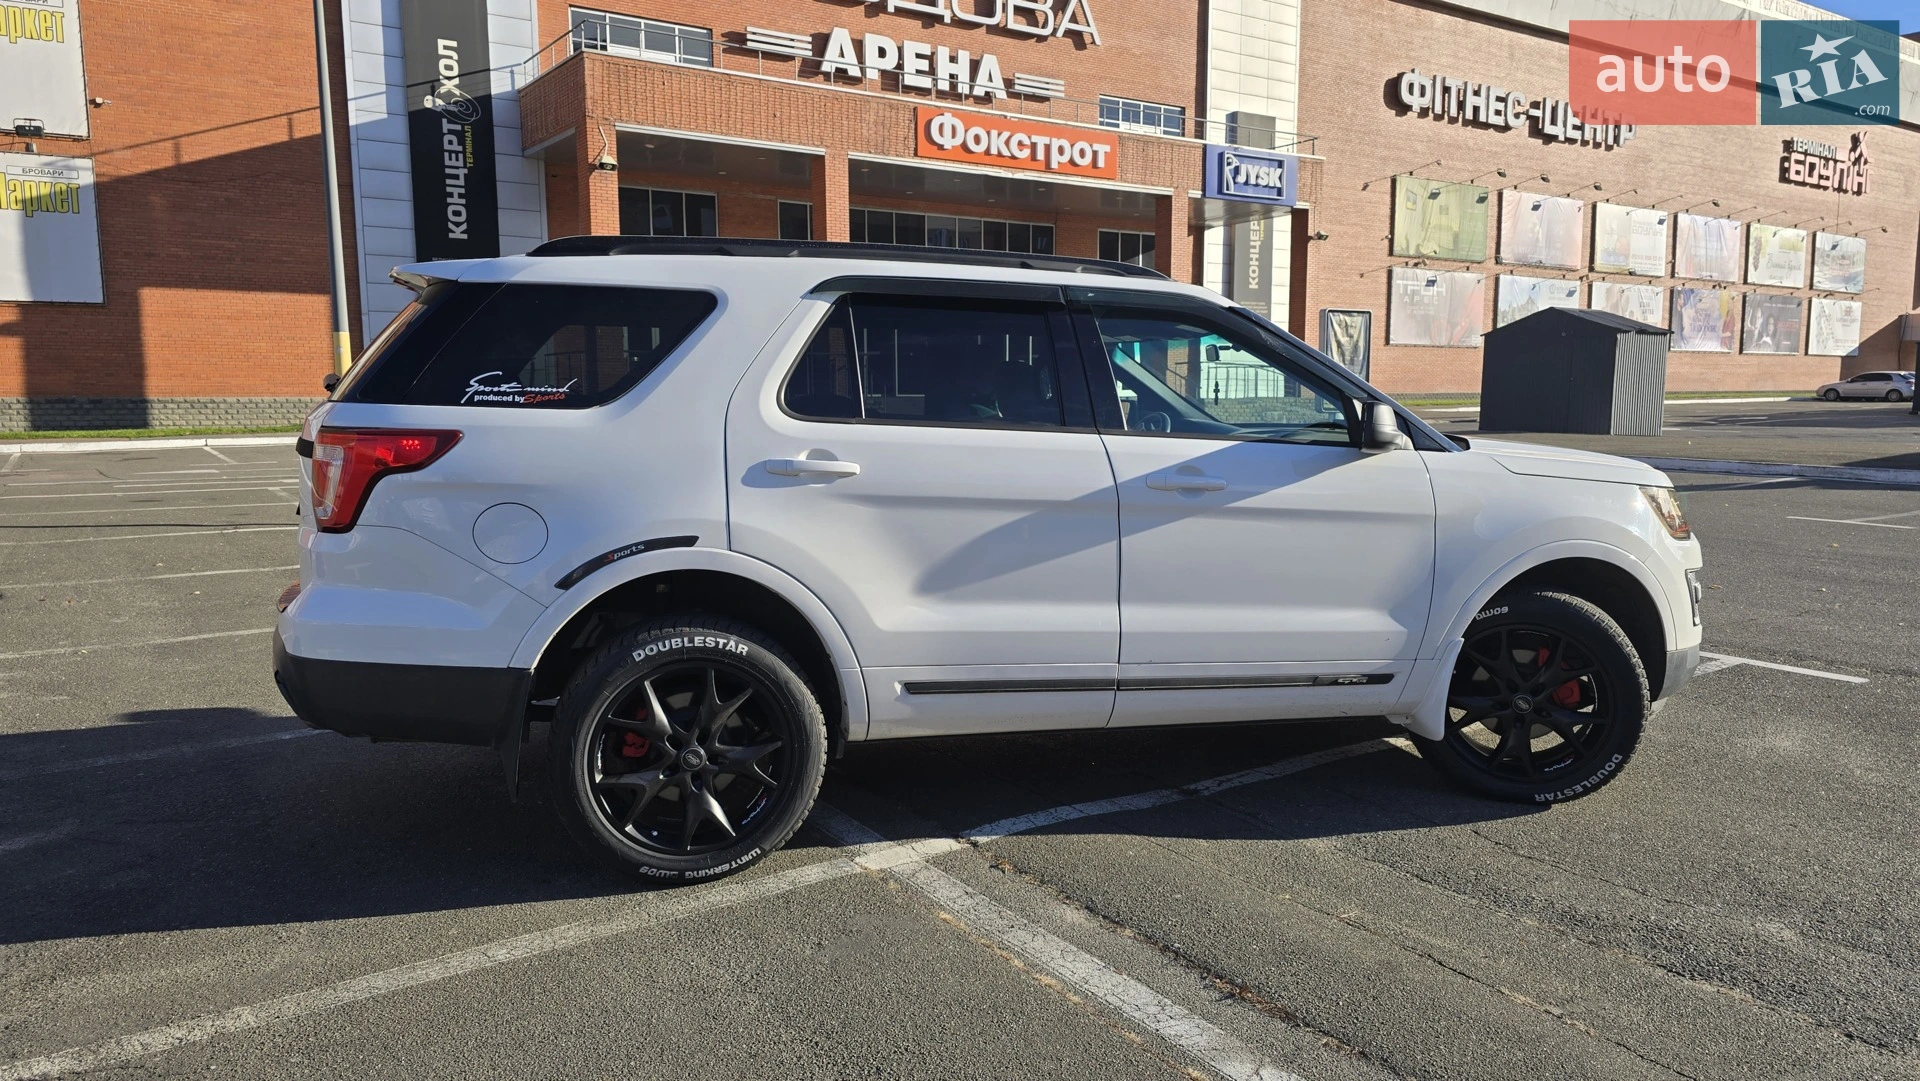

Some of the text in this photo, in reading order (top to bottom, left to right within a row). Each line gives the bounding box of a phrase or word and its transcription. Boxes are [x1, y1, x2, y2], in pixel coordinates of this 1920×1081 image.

[437, 38, 460, 96] ХОЛ
[820, 27, 1008, 99] АРЕНА
[1399, 68, 1638, 148] ФІТНЕС-ЦЕНТР
[930, 112, 1110, 170] Фокстрот
[1792, 136, 1837, 159] ТЕРМІНАЛ
[22, 167, 64, 177] БРОВАРИ
[442, 118, 468, 240] КОНЦЕРТ
[1235, 163, 1283, 188] JYSK
[474, 393, 566, 403] produced by Sports
[604, 543, 645, 562] Sports
[632, 636, 749, 662] DOUBLESTAR
[1534, 753, 1623, 802] DOUBLESTAR
[684, 847, 762, 880] WINTERKING
